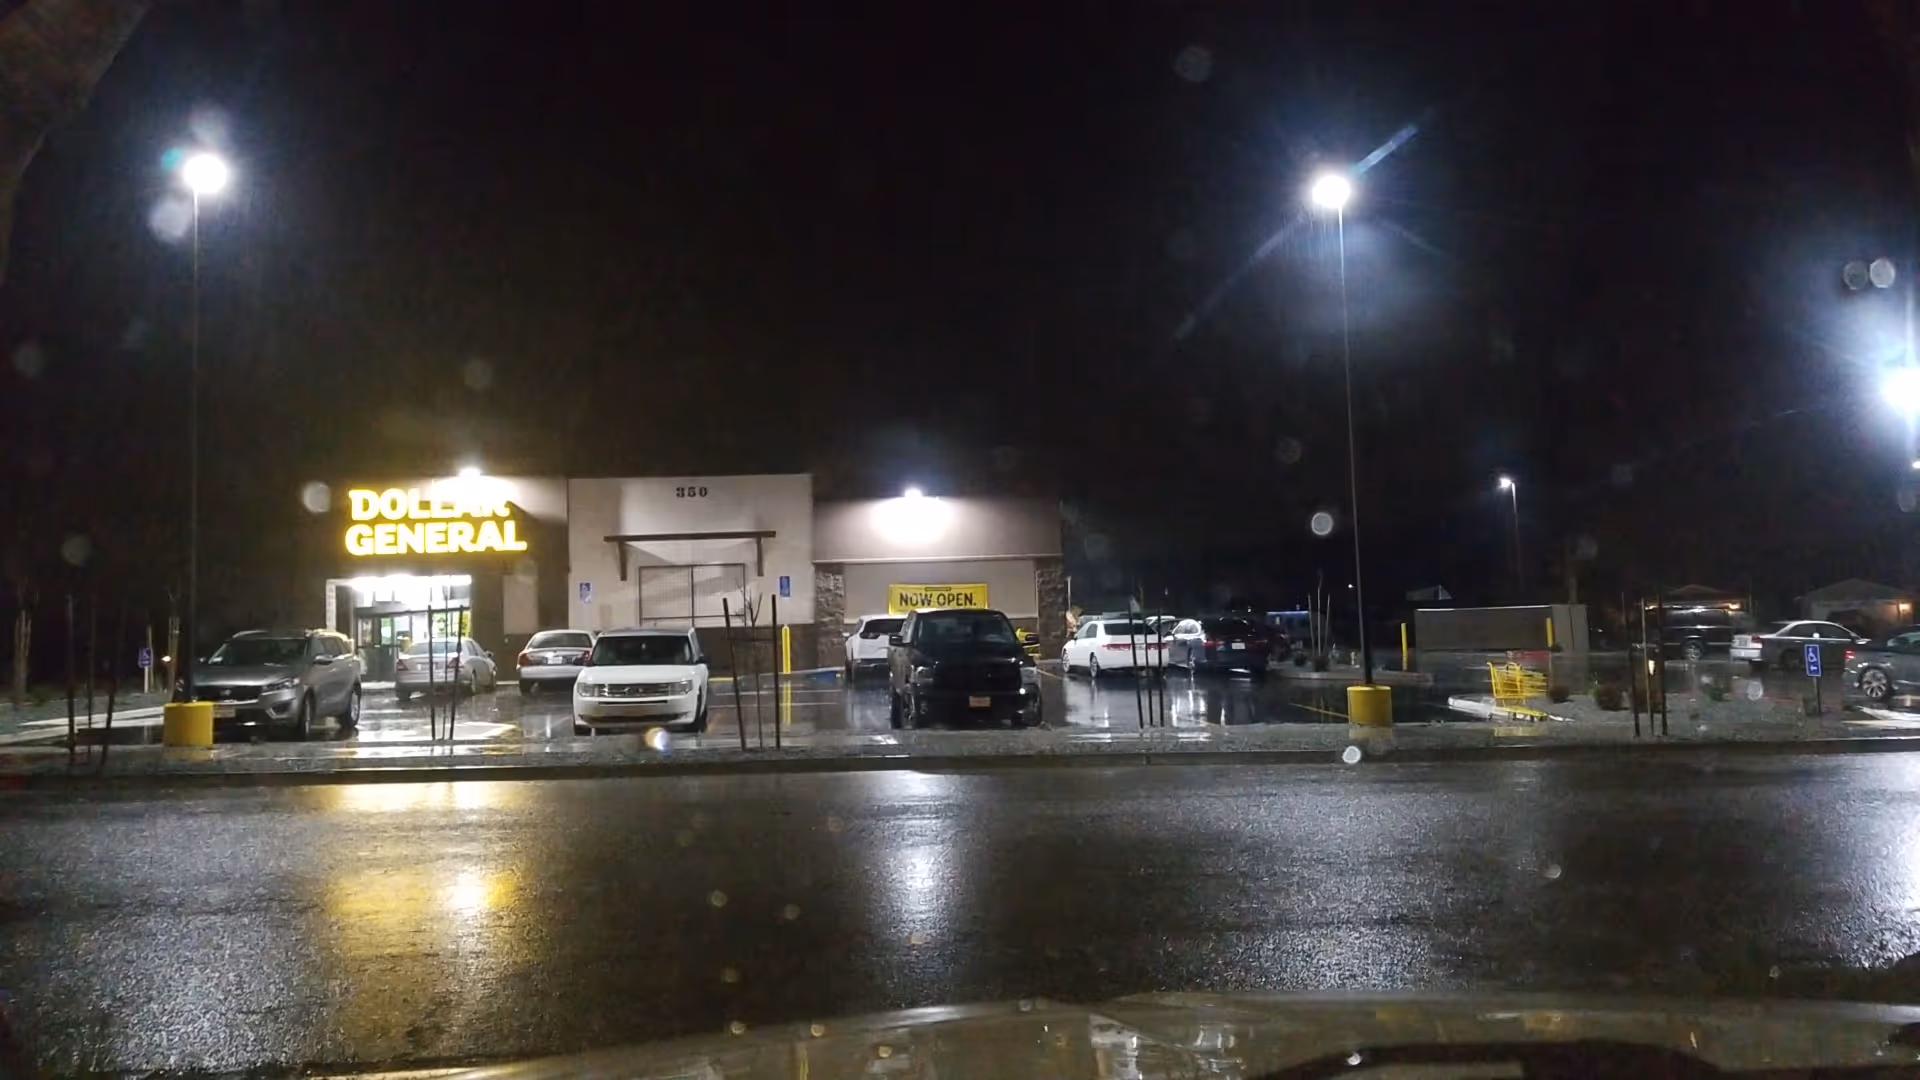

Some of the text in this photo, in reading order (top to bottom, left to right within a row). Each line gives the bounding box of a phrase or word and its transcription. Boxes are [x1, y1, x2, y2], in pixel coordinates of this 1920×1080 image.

[676, 486, 708, 498] 350
[345, 520, 528, 556] GENERAL
[899, 592, 977, 607] NOW OPEN.
